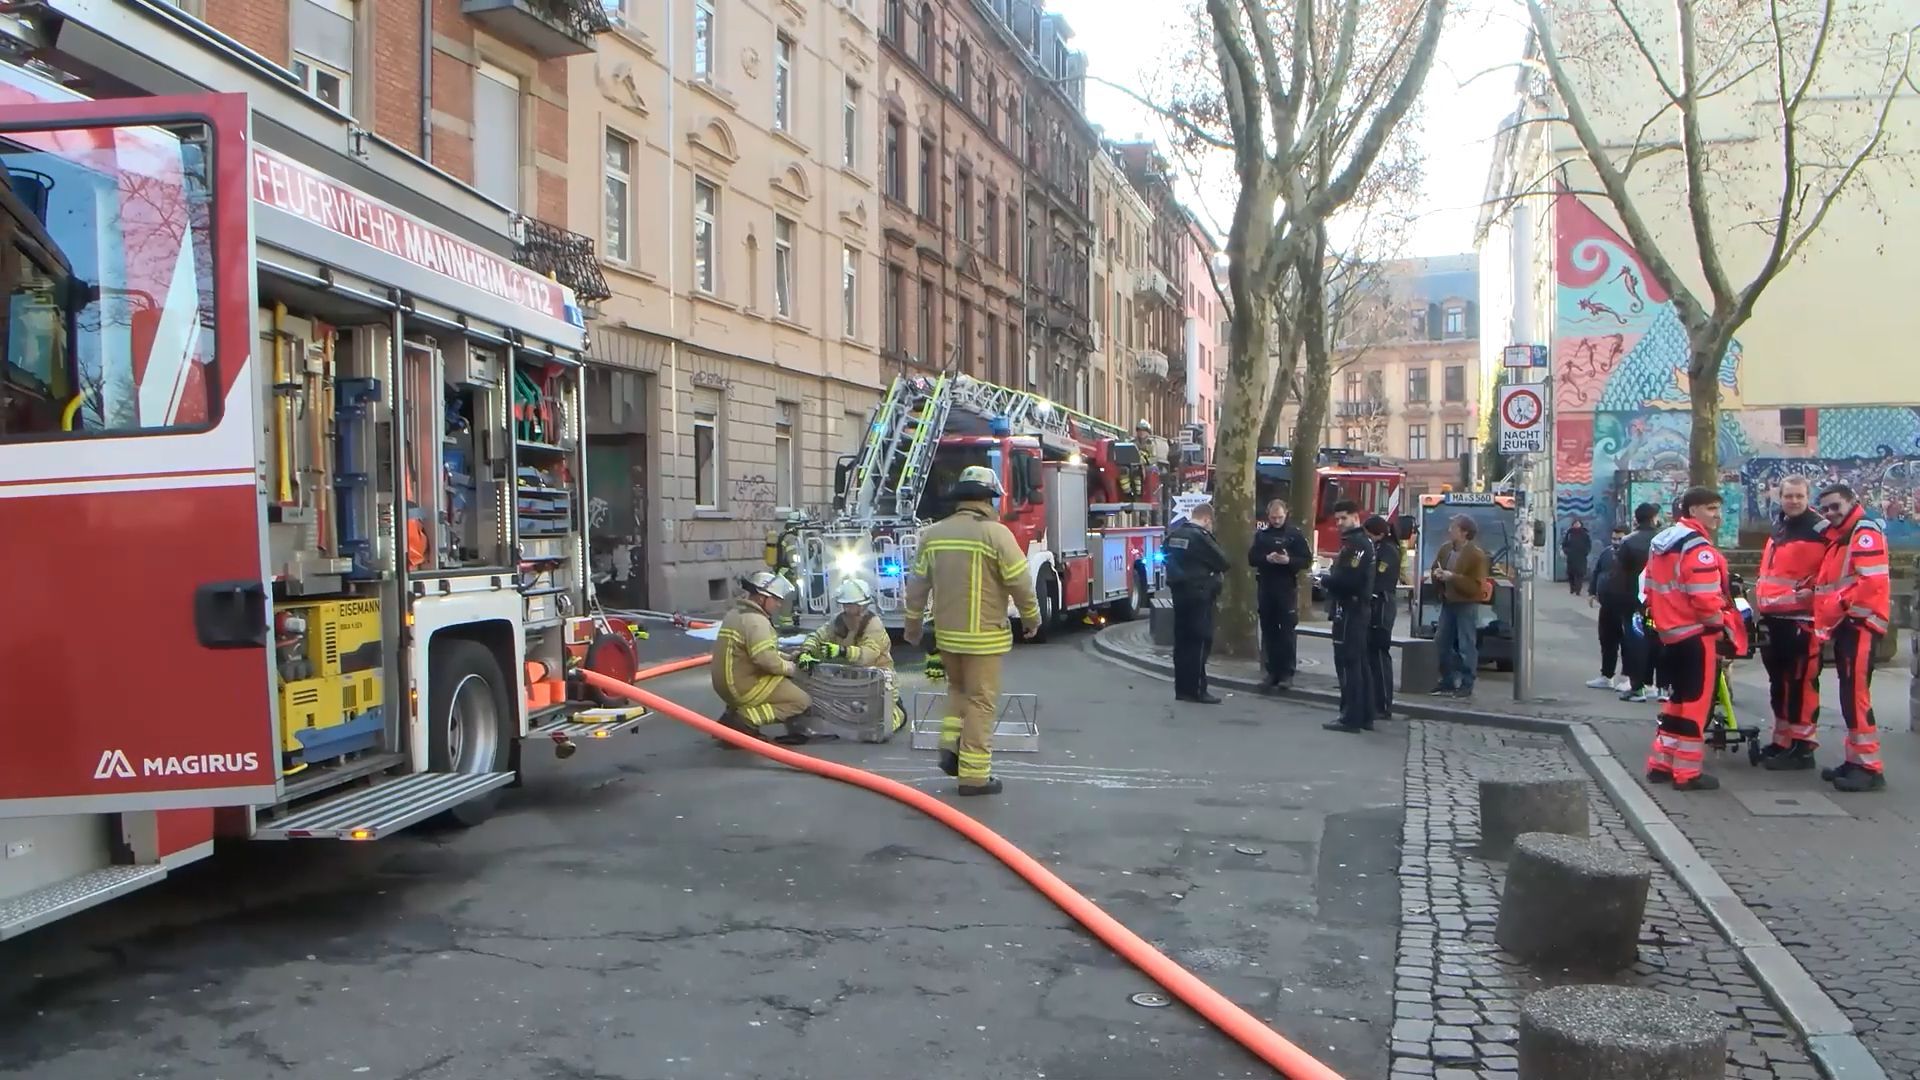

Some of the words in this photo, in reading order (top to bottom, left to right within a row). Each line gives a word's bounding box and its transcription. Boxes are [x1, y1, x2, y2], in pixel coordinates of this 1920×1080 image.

[253, 152, 402, 256] FEUERWEHR
[402, 219, 508, 299] MANNHEIM
[523, 277, 555, 316] 112
[1504, 430, 1540, 439] NACHT
[339, 600, 380, 617] EISEMANN
[143, 752, 259, 776] MAGIRUS
